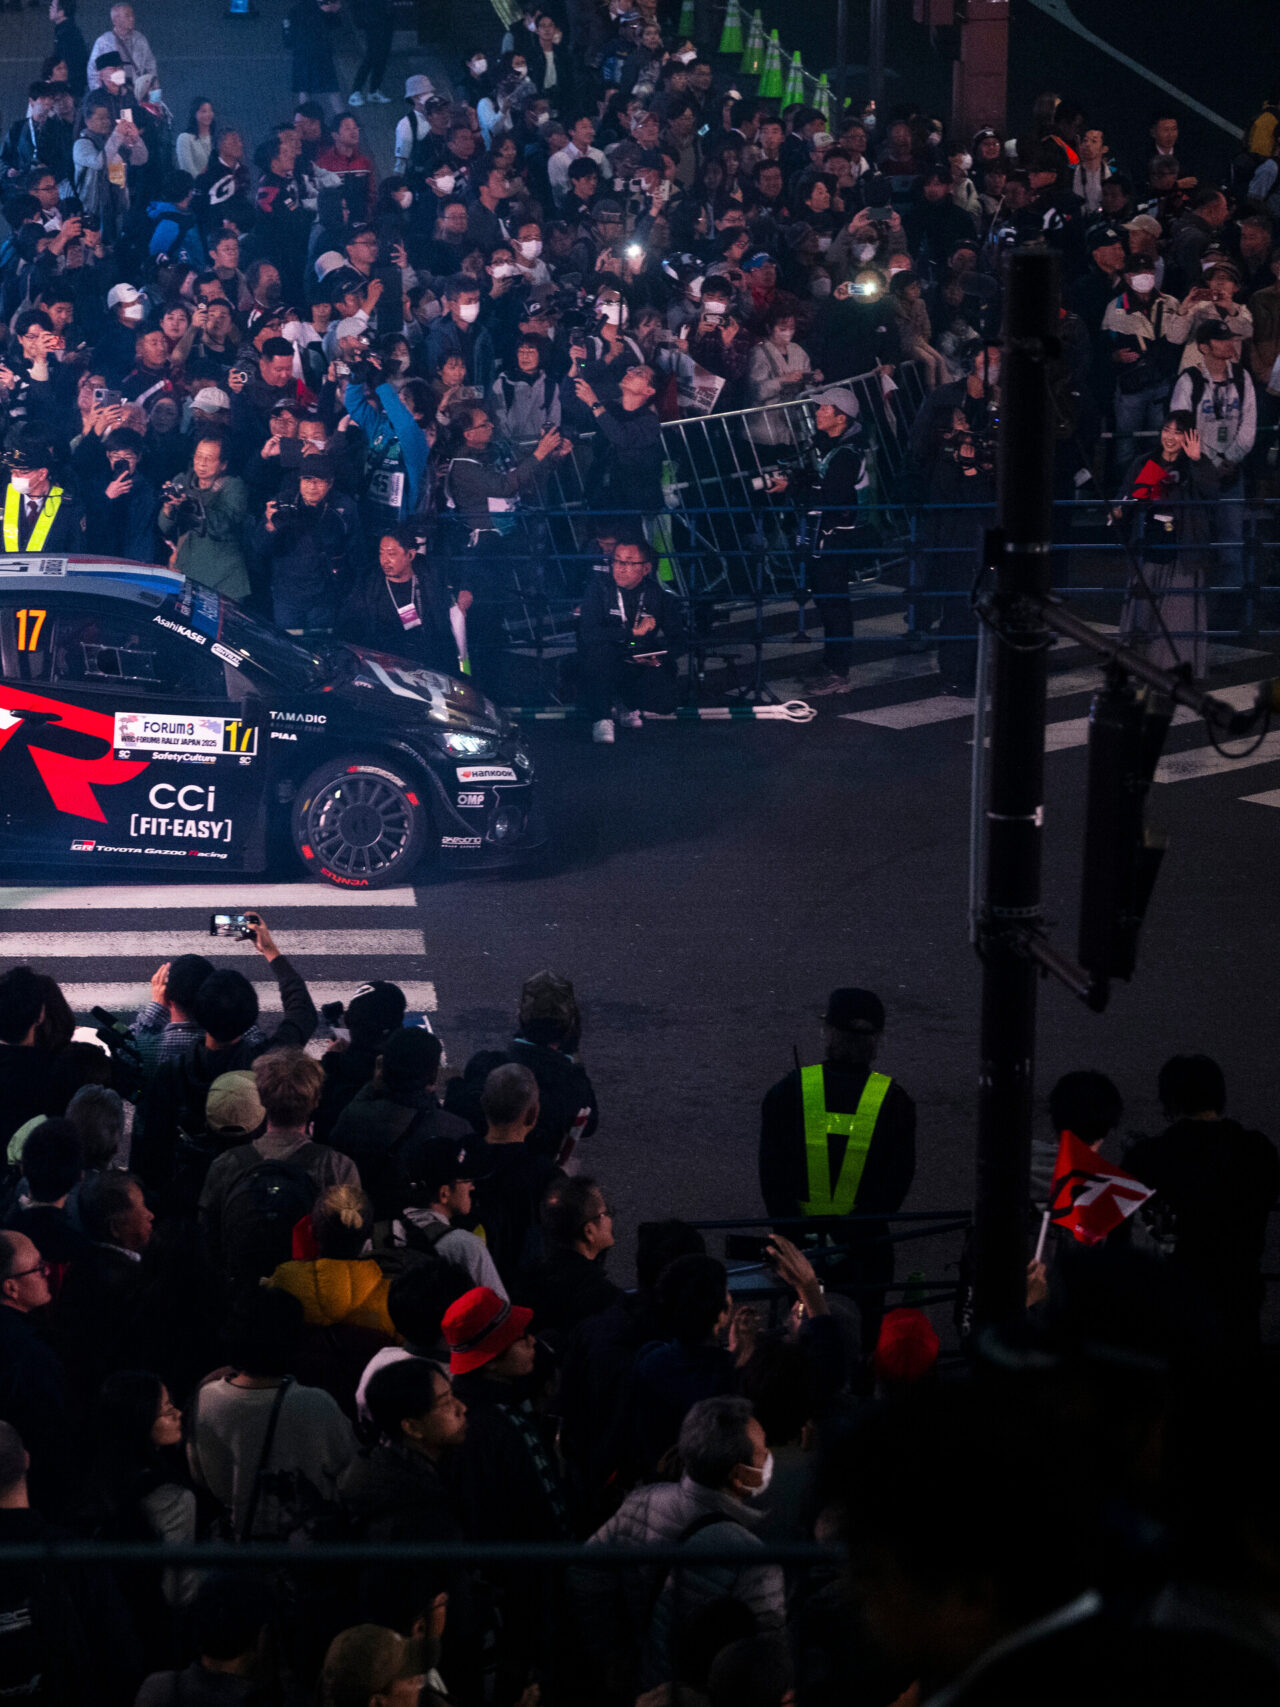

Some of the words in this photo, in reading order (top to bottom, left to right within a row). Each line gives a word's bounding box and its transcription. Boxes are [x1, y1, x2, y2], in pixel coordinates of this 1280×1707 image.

[16, 608, 47, 652] 17
[269, 710, 327, 724] TAMADIC
[270, 731, 298, 741] PIAA
[152, 752, 217, 763] SafetyCulture
[457, 794, 485, 806] OMP
[96, 845, 142, 854] TOYOTA
